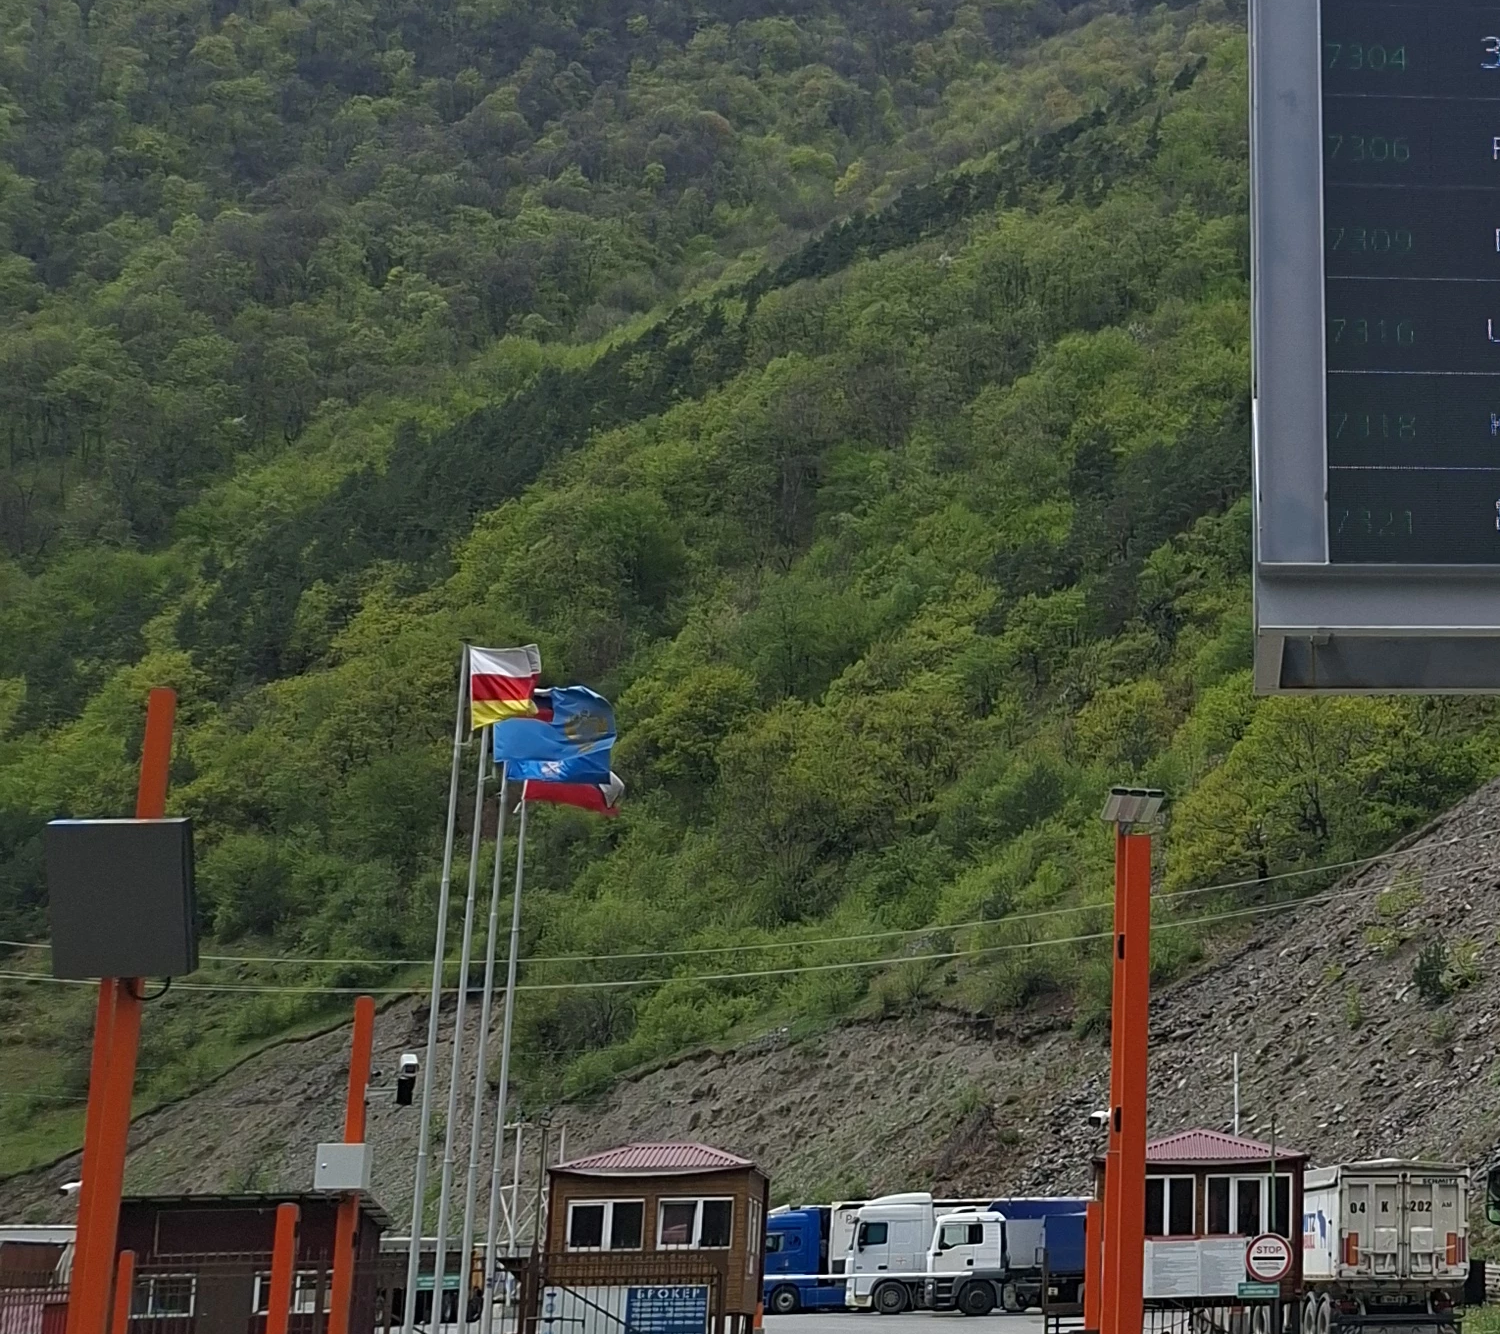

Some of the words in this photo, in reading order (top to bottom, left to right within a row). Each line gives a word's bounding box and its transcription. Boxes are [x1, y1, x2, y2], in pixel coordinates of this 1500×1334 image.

[1422, 1177, 1458, 1185] SCHMITZ
[1350, 1202, 1366, 1214] 04
[1381, 1201, 1389, 1213] K
[1410, 1200, 1432, 1212] 202
[1256, 1245, 1283, 1255] STOP
